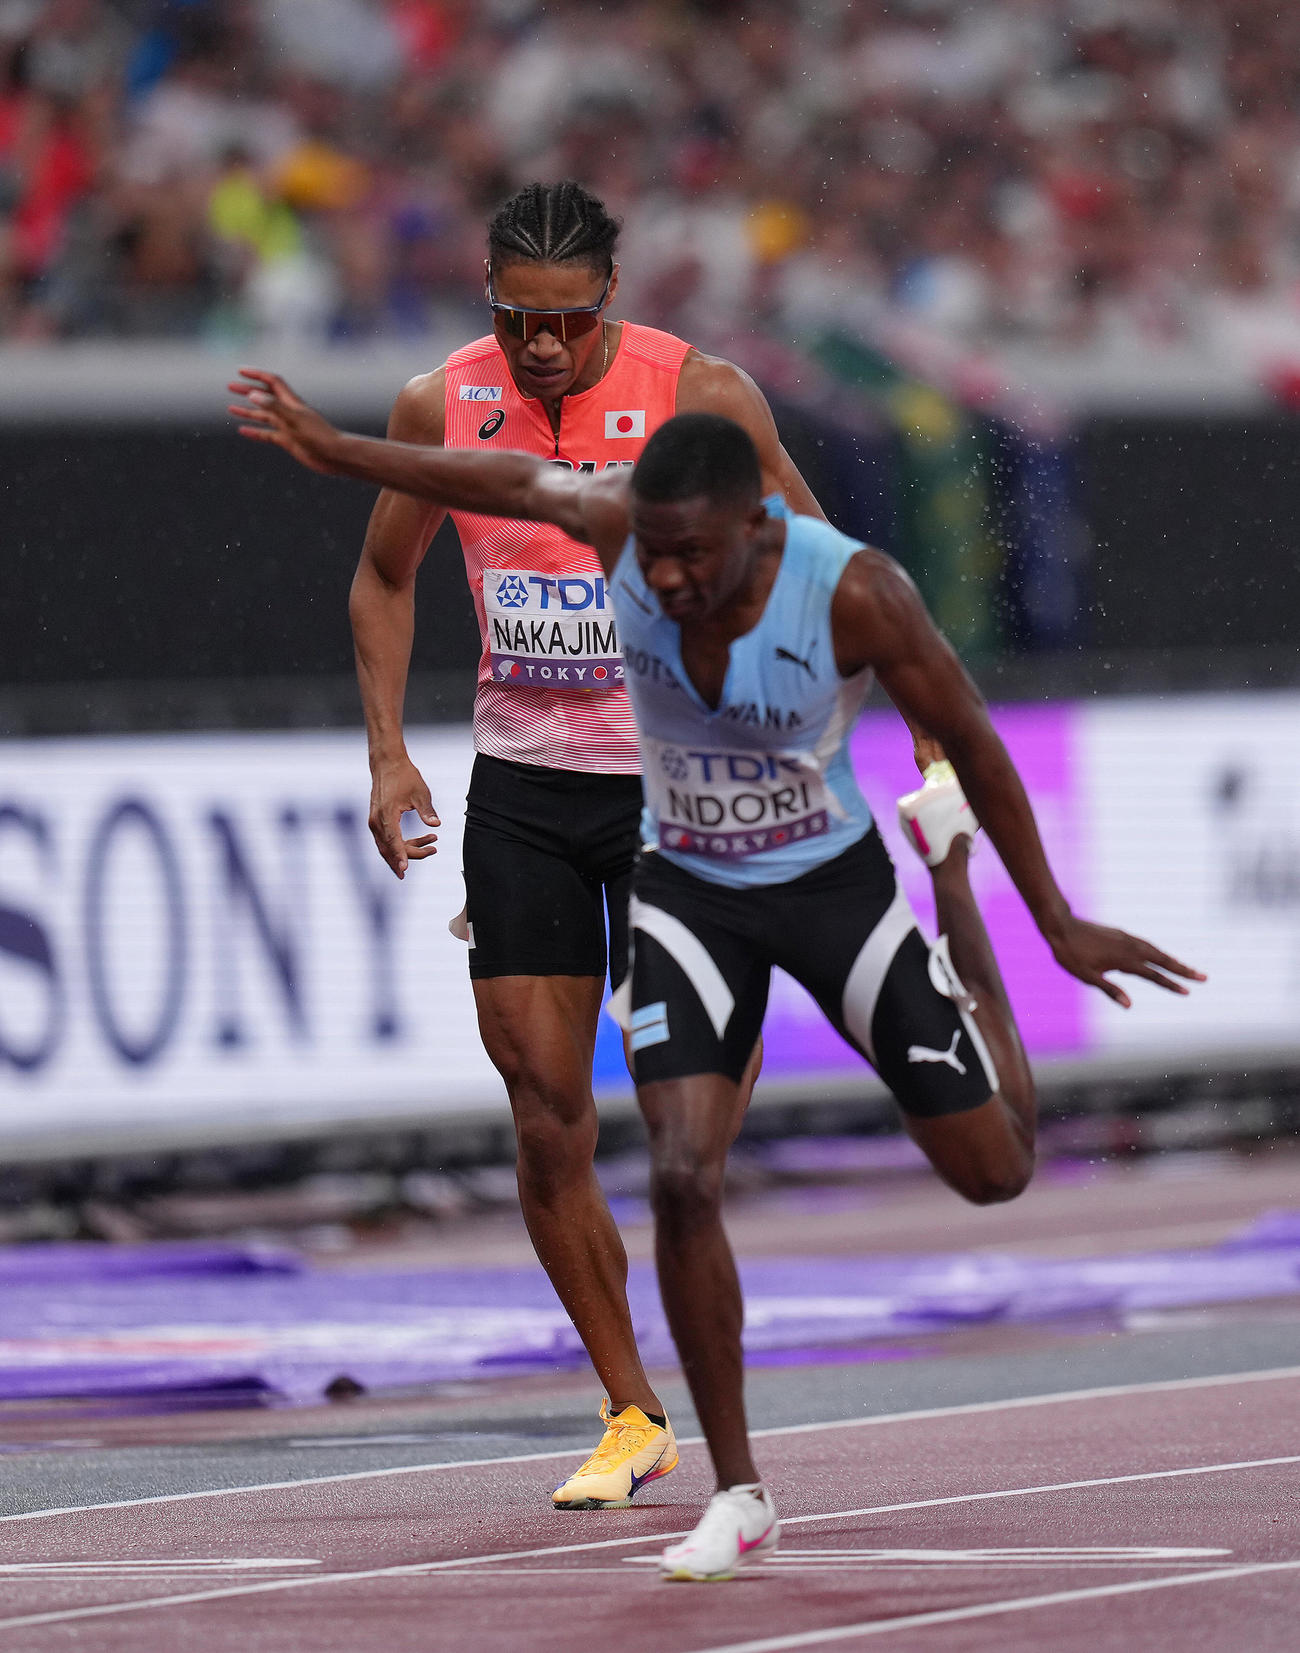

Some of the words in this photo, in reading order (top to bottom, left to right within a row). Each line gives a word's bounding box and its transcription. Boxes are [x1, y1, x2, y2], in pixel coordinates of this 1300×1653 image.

[461, 387, 501, 400] ACN
[493, 617, 623, 656] NAKAJIM
[668, 781, 809, 827] NDORI
[0, 798, 412, 1070] SONY
